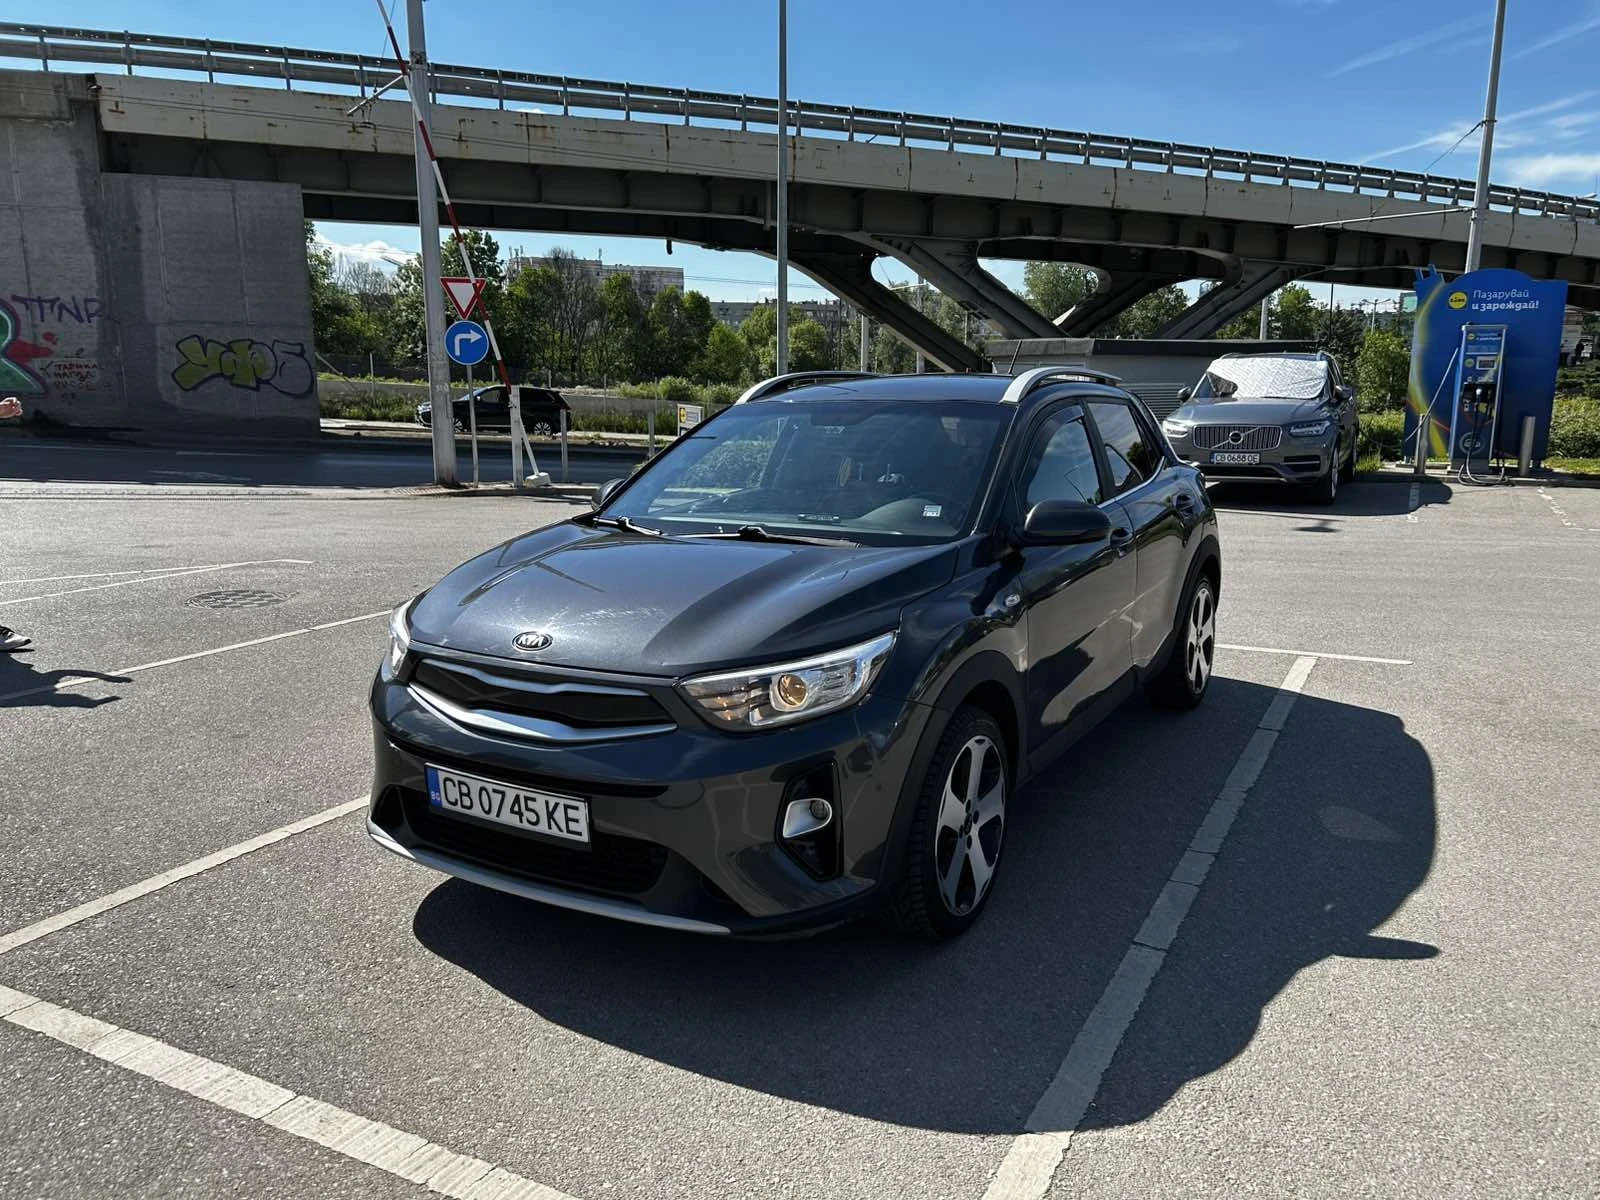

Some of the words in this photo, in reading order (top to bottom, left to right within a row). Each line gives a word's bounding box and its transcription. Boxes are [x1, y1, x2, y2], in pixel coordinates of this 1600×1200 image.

[1473, 288, 1529, 300] Пазарувай
[1480, 300, 1539, 311] зареждай!
[1215, 454, 1226, 462] CB
[1227, 454, 1246, 462] 0688
[443, 777, 474, 810] CB
[478, 786, 540, 826] 0745
[545, 800, 583, 837] KE
